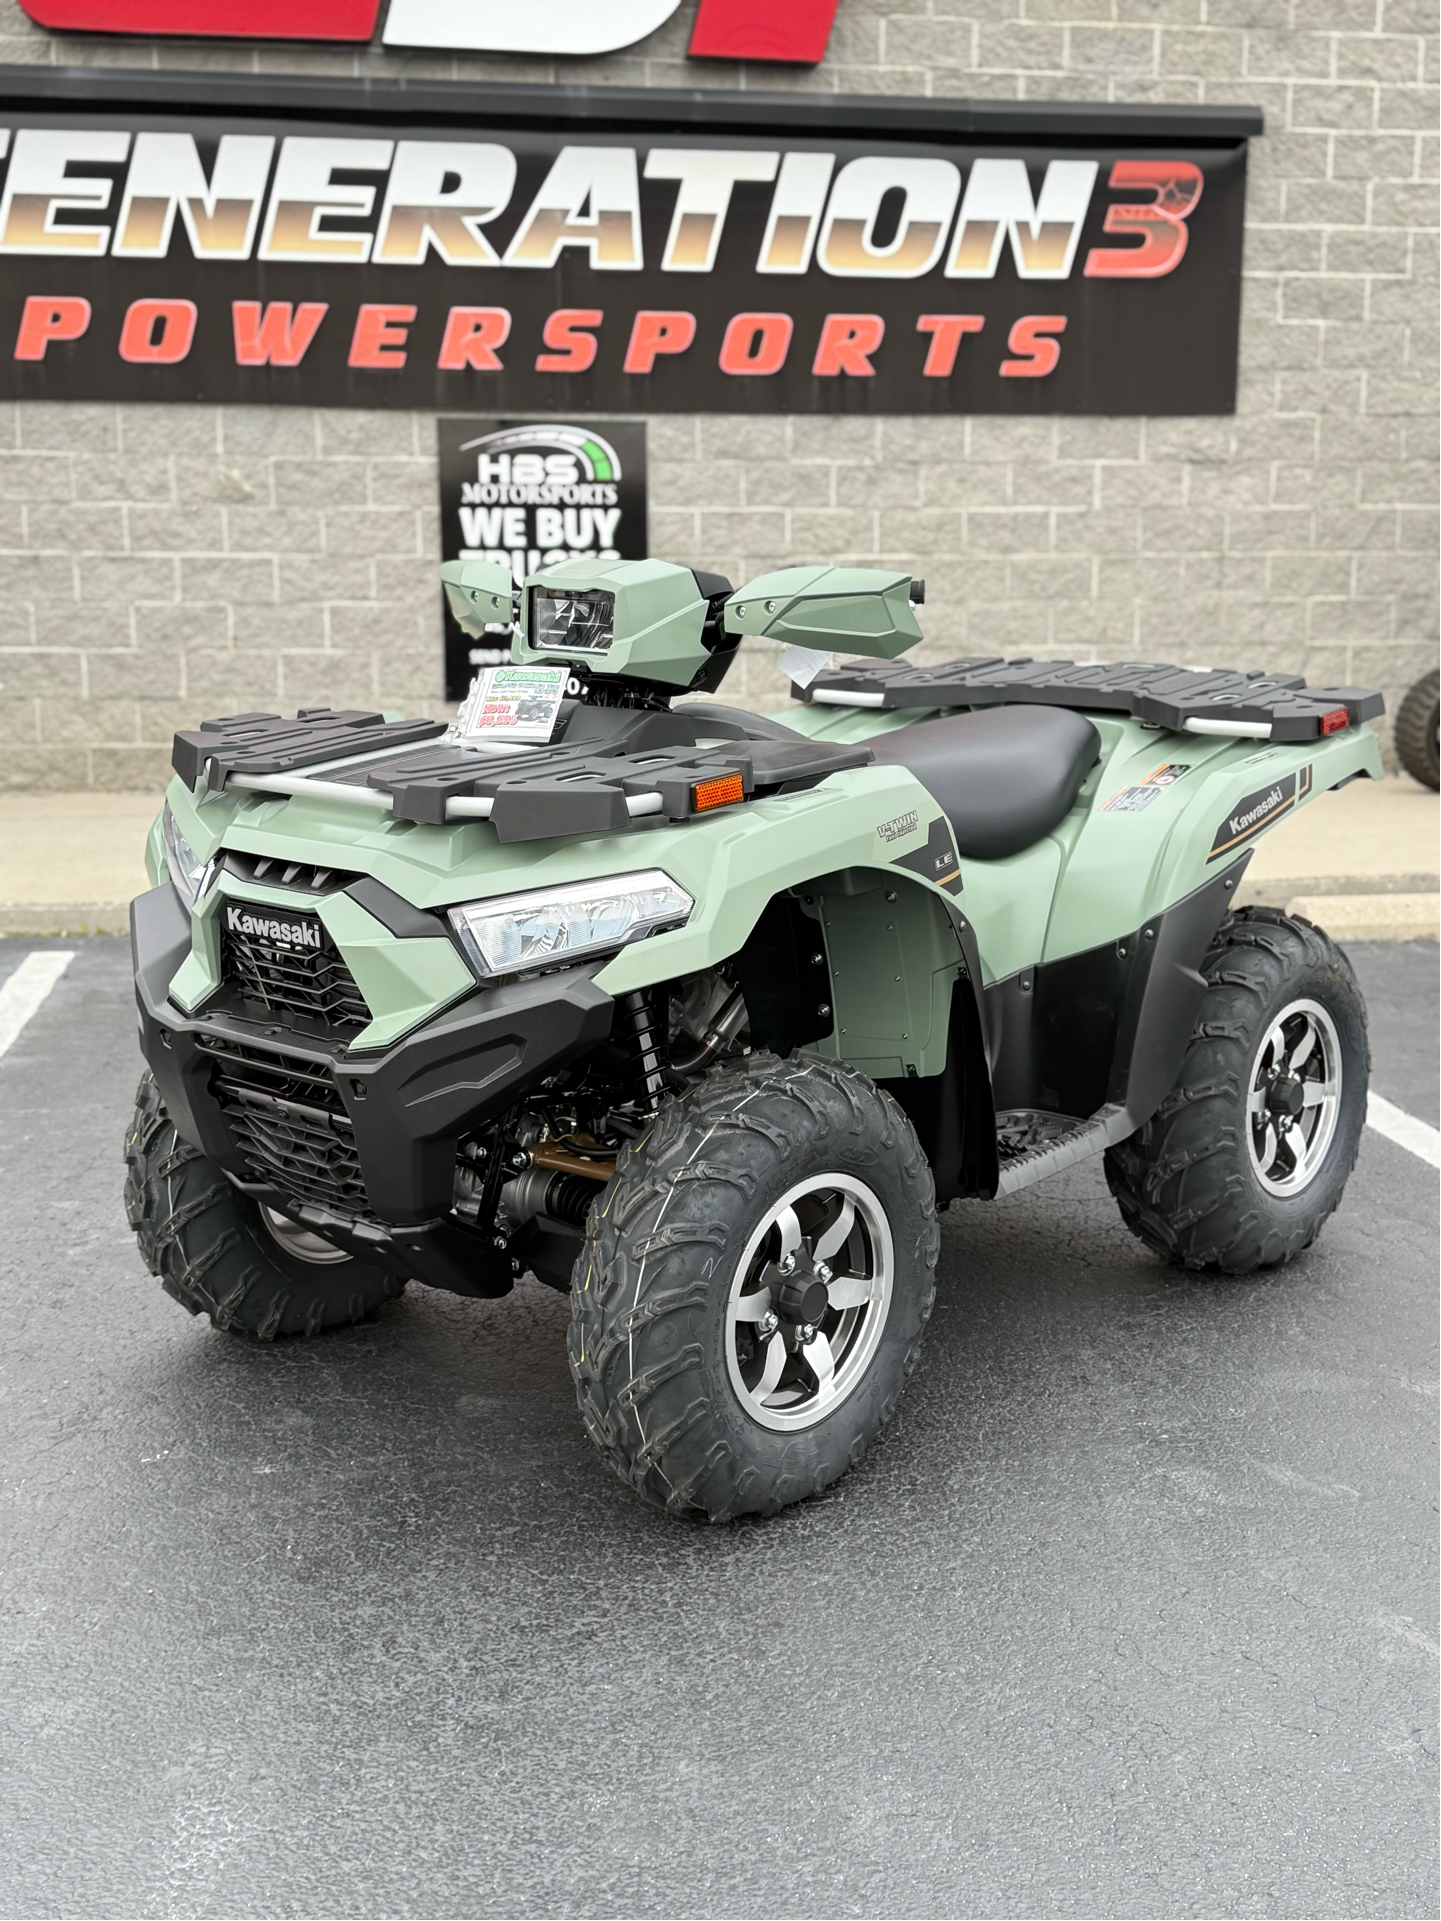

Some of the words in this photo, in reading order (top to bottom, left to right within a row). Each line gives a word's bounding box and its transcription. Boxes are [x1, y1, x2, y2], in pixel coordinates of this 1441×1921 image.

[13, 295, 1068, 377] POWERSPORTS
[478, 453, 579, 485] HBS
[461, 482, 618, 505] MOTORSPORTS
[458, 507, 527, 548] WE
[535, 507, 622, 549] BUY
[504, 670, 561, 683] Kawasaki
[876, 809, 919, 838] V-TWIN
[1229, 787, 1283, 834] Kawasaki
[935, 852, 953, 868] LE
[226, 906, 321, 948] Kawasaki
